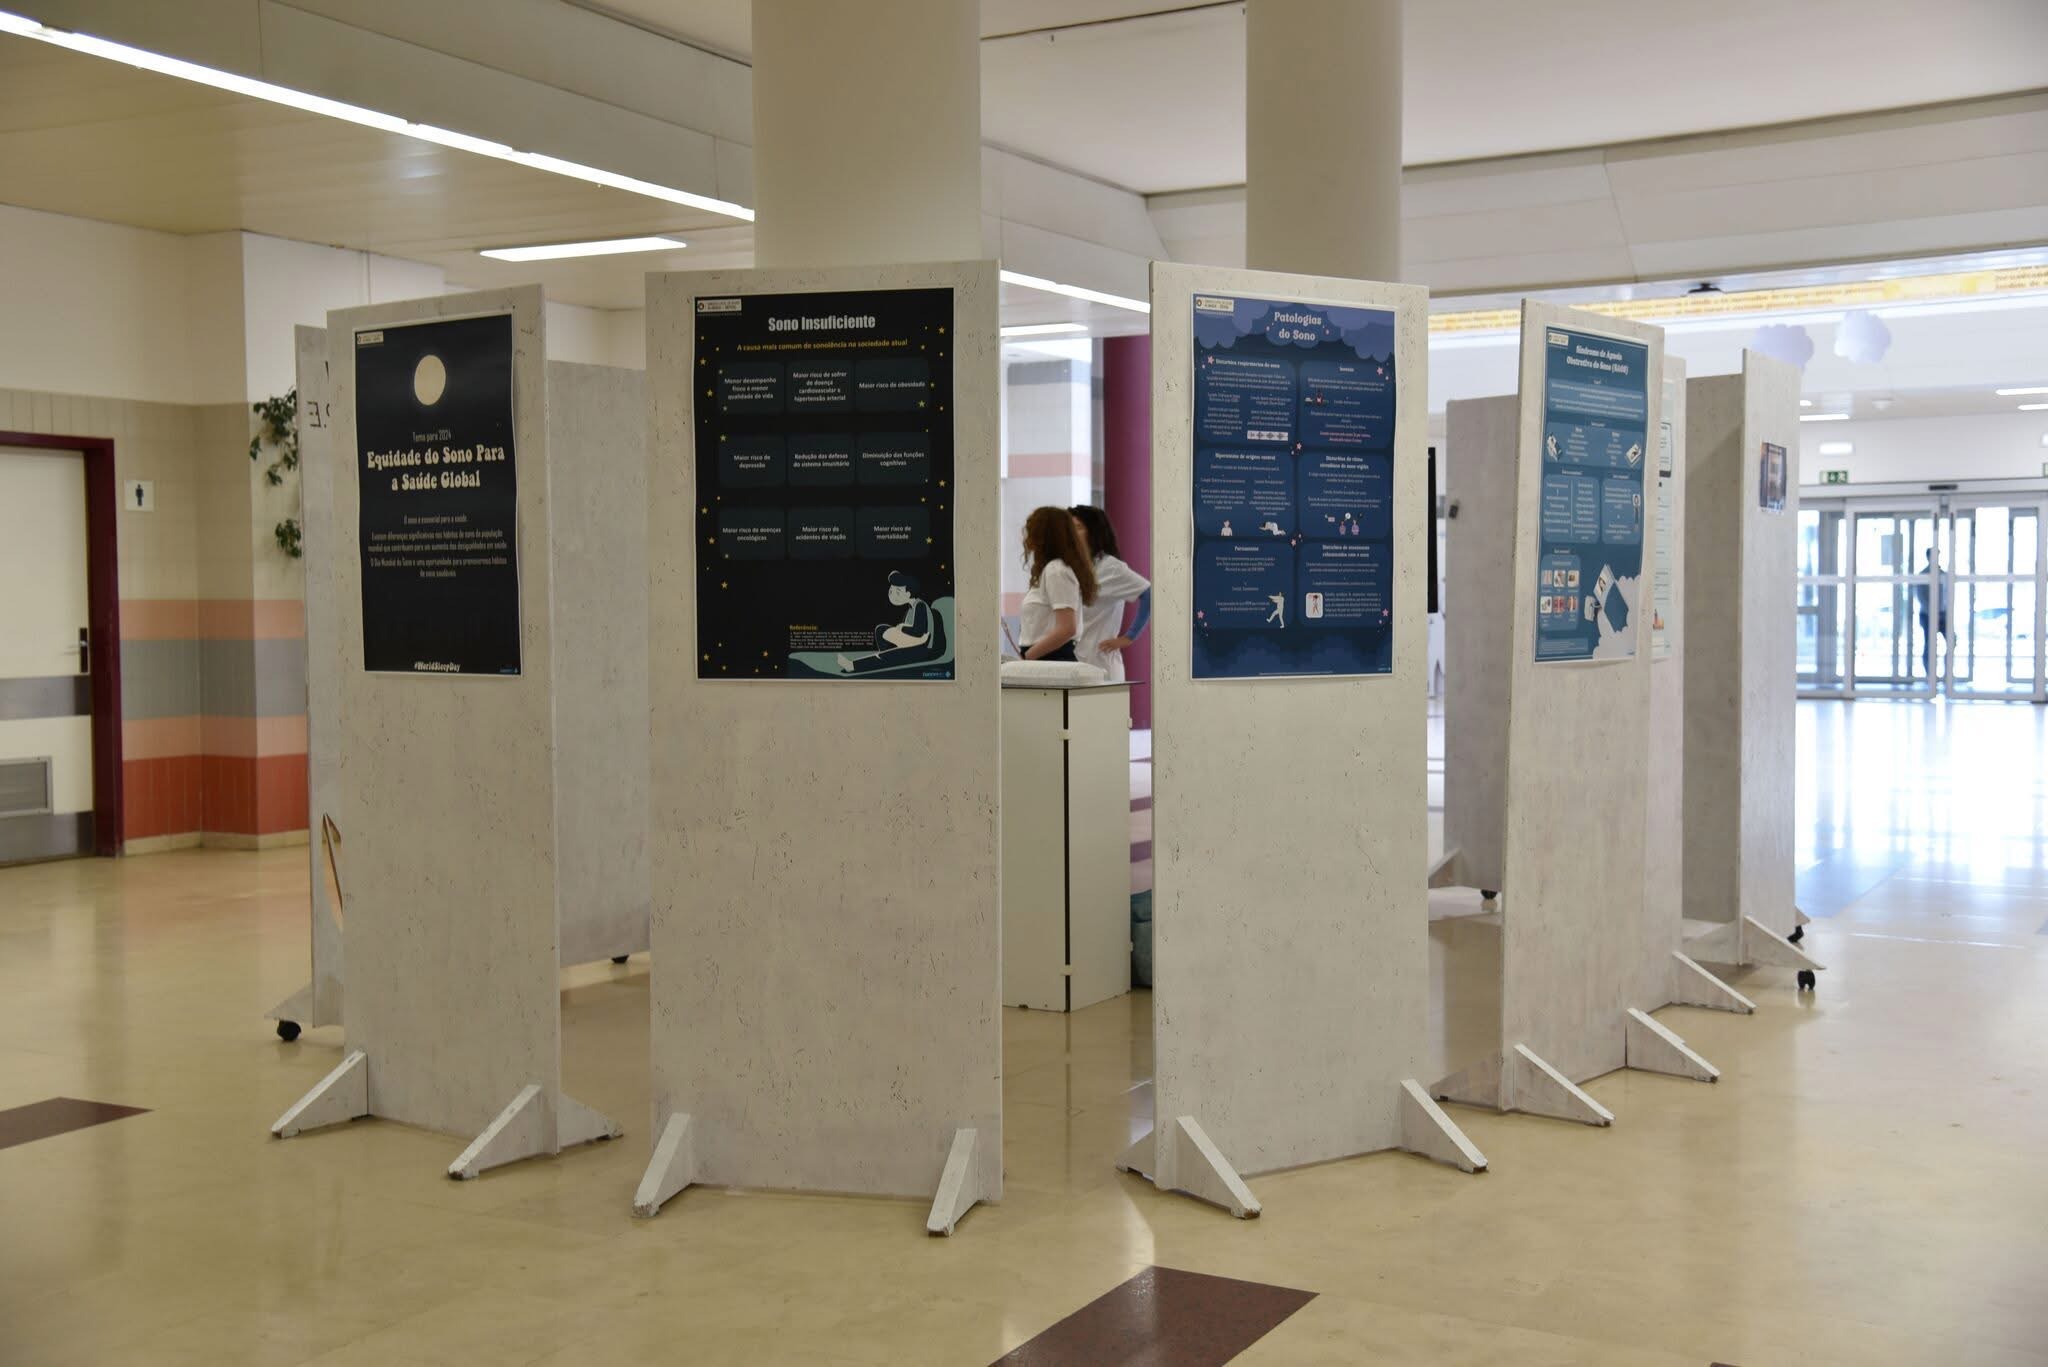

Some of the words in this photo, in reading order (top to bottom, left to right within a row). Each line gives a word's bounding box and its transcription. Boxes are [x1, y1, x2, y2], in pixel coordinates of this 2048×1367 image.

[768, 317, 799, 332] Sono
[801, 315, 876, 331] Insuficiente
[1274, 311, 1322, 327] Patologias
[1278, 328, 1291, 339] do
[1292, 329, 1316, 341] Sono
[762, 343, 777, 351] mais
[778, 343, 802, 351] comum
[803, 341, 811, 350] de
[812, 340, 847, 349] sonolência
[858, 339, 889, 348] sociedade
[891, 338, 908, 347] atual
[793, 371, 809, 379] Maior
[823, 370, 830, 378] de
[831, 370, 847, 378] sofrer
[859, 381, 876, 389] Maior
[876, 381, 889, 389] risco
[889, 380, 897, 388] de
[897, 380, 926, 388] obesidade
[798, 387, 837, 395] cardiovascular
[728, 393, 754, 402] qualidade
[761, 392, 774, 400] vida
[412, 431, 426, 443] Tema
[426, 433, 438, 443] para
[438, 429, 452, 441] 2024
[367, 448, 421, 471] Equidade
[424, 448, 440, 465] do
[442, 446, 473, 464] Sono
[475, 444, 505, 462] Para
[794, 453, 818, 461] Redução
[828, 452, 848, 460] defesas
[862, 451, 893, 459] Diminuição
[903, 451, 925, 459] funções
[822, 460, 850, 468] imunitário
[879, 460, 907, 468] cognitivas
[391, 477, 399, 491] a
[401, 472, 438, 490] Saúde
[440, 470, 481, 489] Global
[414, 660, 461, 673] #WorldSleepDay
